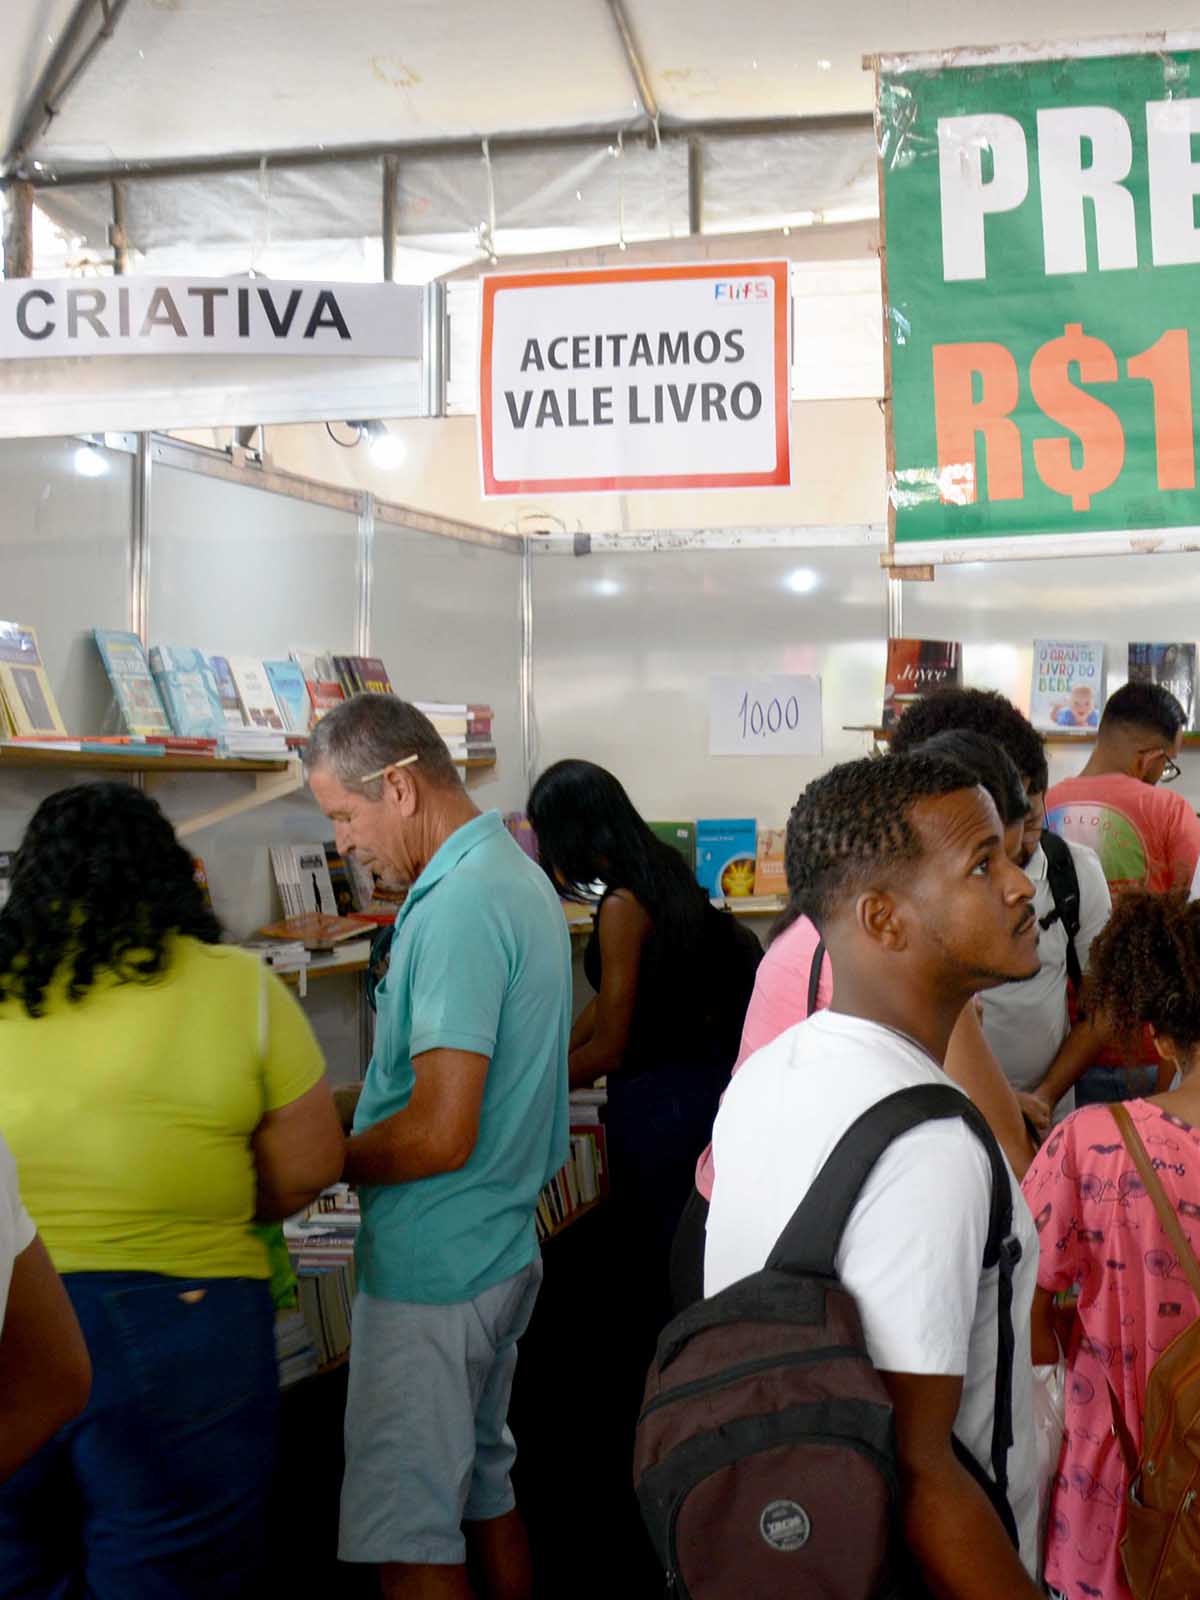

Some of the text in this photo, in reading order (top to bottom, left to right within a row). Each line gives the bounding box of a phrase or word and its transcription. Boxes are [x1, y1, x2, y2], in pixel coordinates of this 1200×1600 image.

[16, 287, 352, 341] CRIATIVA
[519, 329, 745, 372] ACEITAMOS
[504, 380, 763, 429] VALE LIVRO
